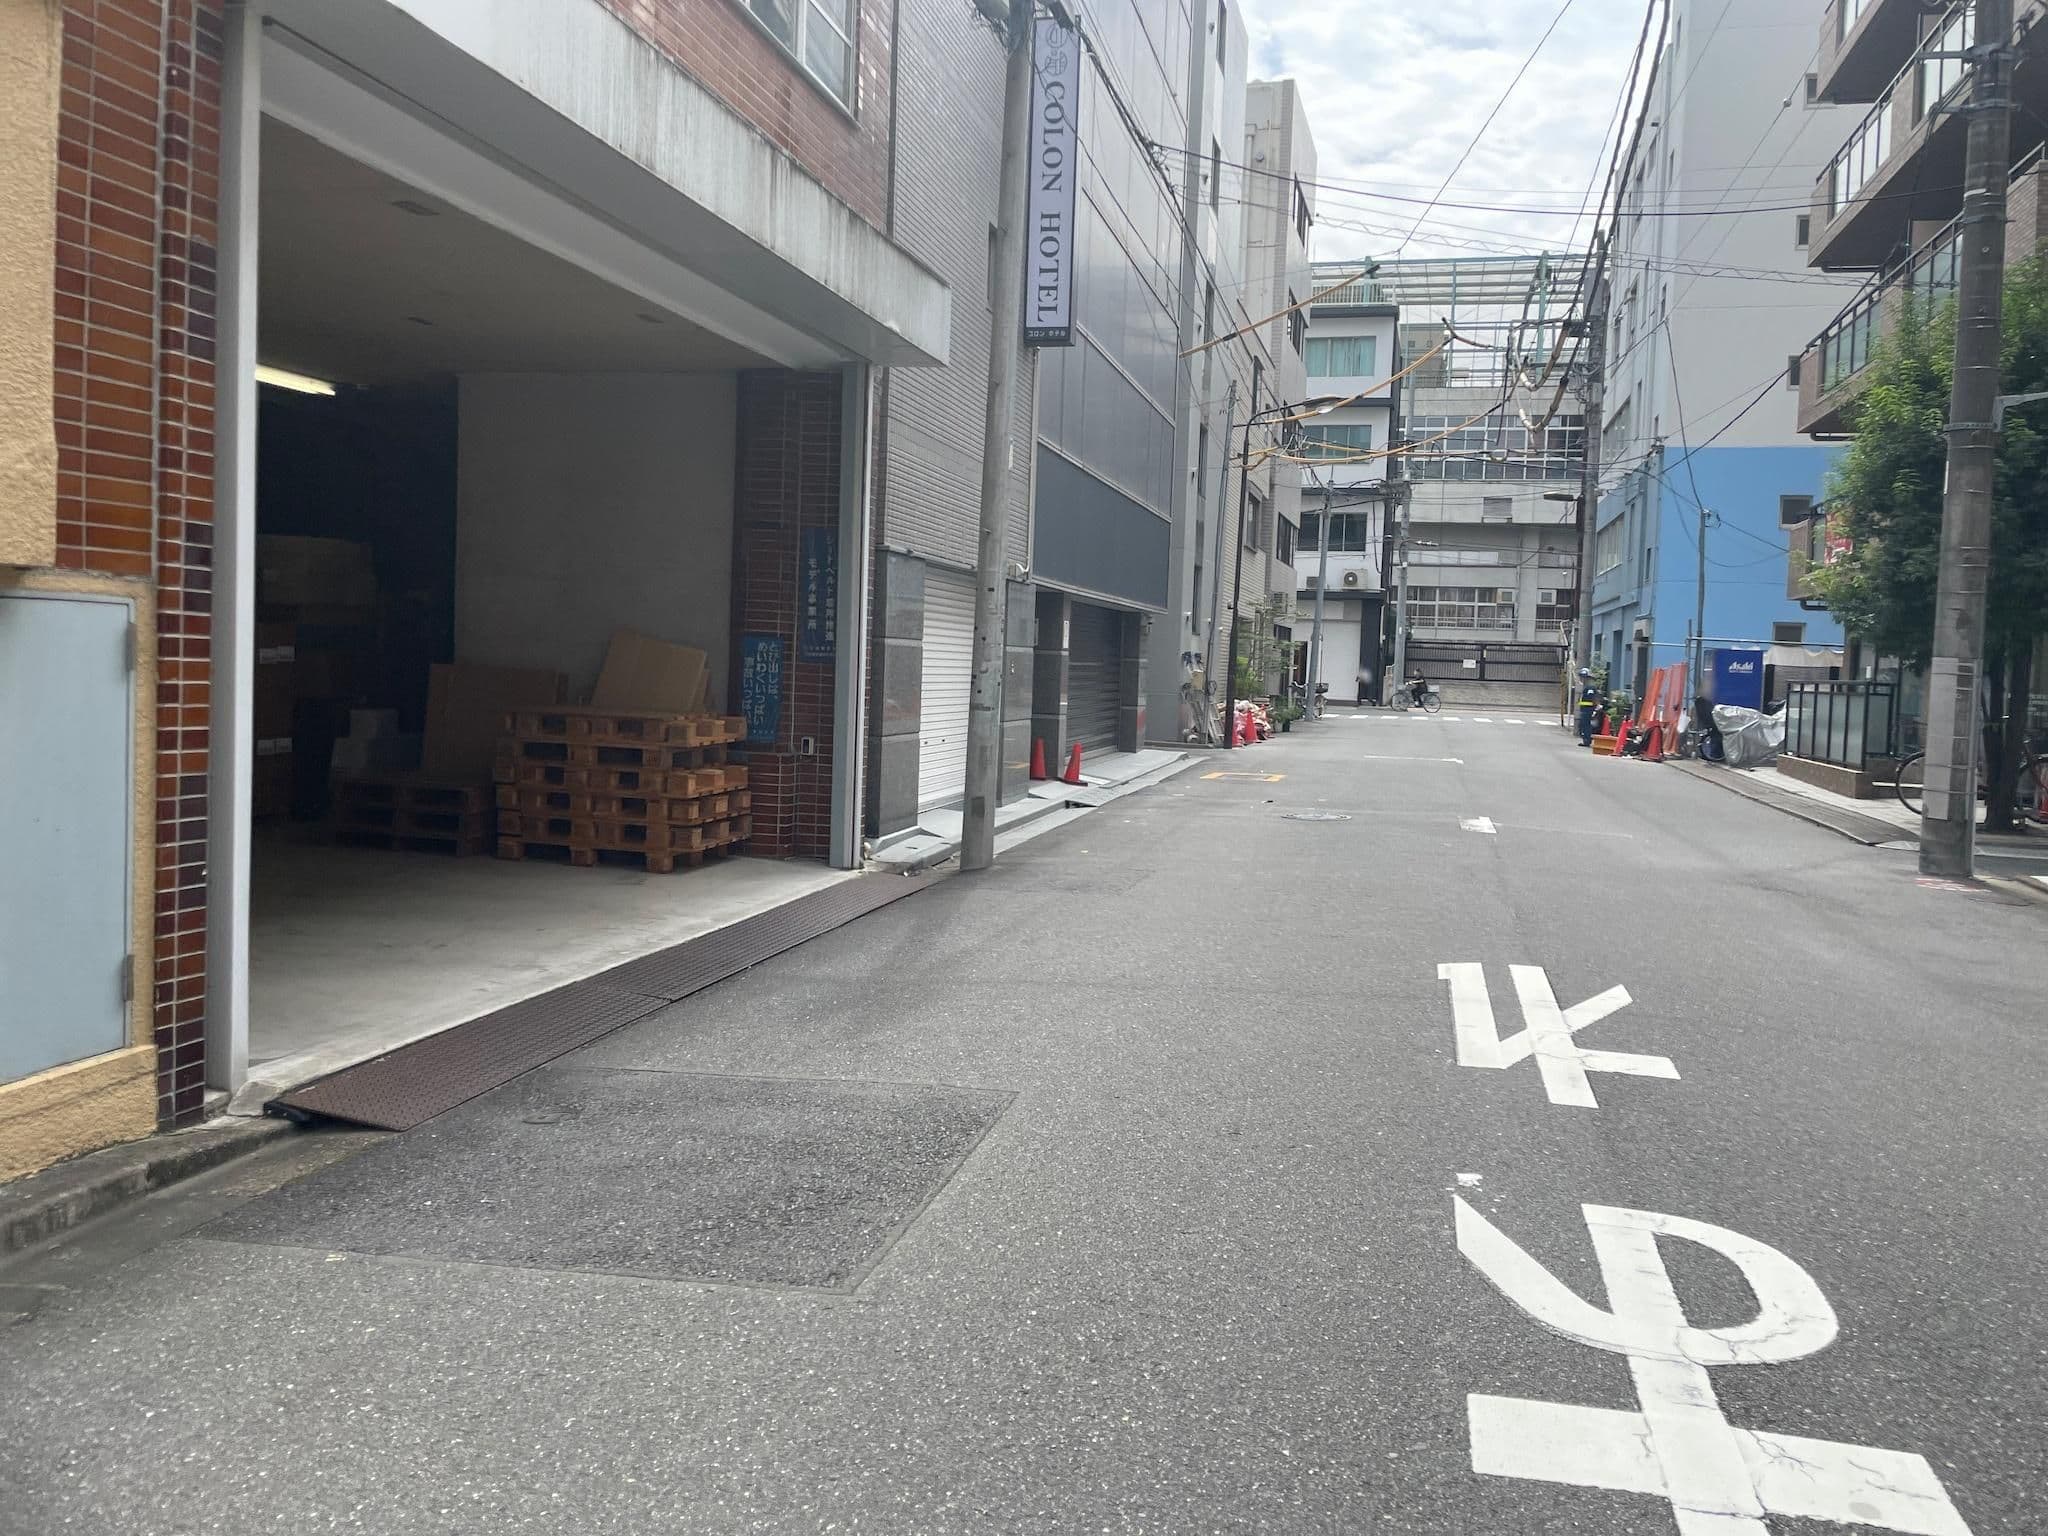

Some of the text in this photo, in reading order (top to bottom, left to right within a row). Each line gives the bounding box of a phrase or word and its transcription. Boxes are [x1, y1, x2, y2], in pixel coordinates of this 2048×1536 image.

[1037, 80, 1066, 323] COLON HOTEL
[1729, 660, 1754, 670] Asahi
